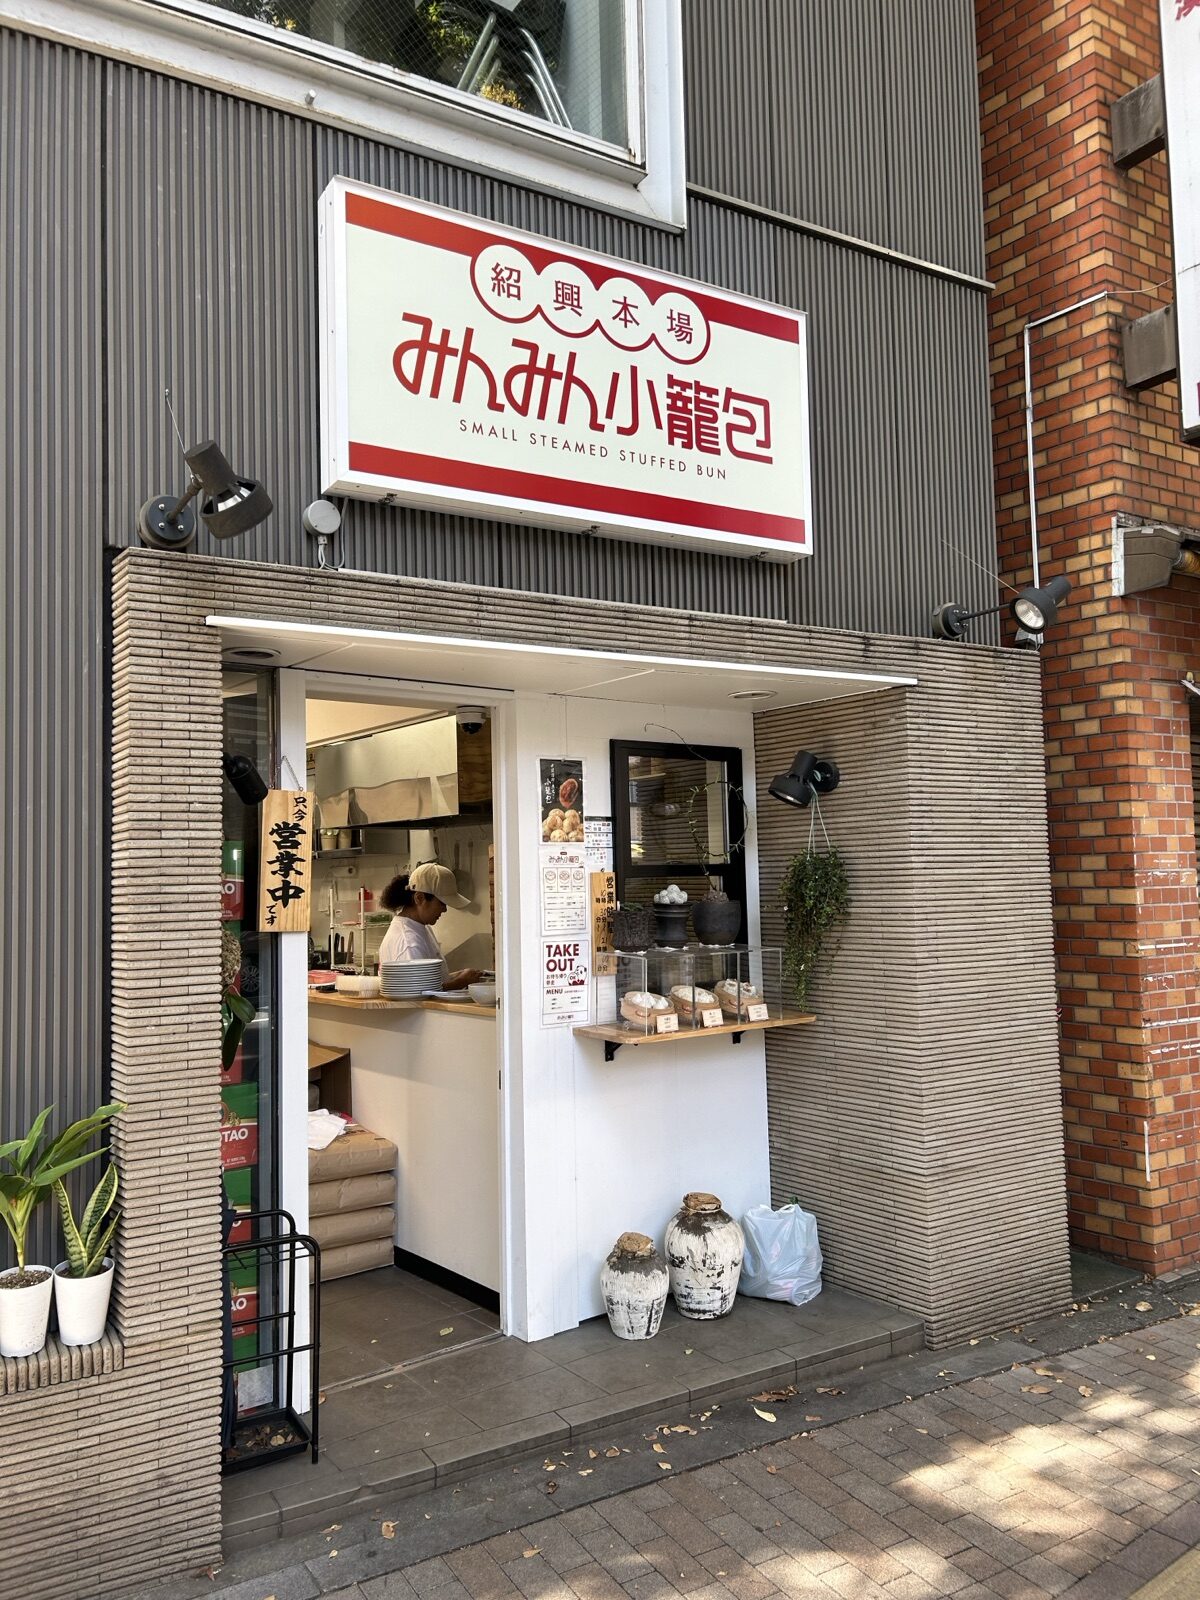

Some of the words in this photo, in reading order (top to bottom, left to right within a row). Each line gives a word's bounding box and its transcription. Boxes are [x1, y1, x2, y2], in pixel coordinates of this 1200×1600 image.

[490, 262, 694, 345] 紹興本場
[392, 312, 774, 464] みんみん小籠包
[459, 419, 518, 442] SMALL
[529, 433, 609, 459] STEAMED
[619, 449, 687, 473] STUFFED
[696, 464, 727, 480] BUN
[292, 796, 307, 821] 只今
[266, 821, 307, 909] 営業中
[264, 902, 278, 927] です
[545, 943, 580, 957] TAKE
[546, 958, 575, 972] OUT
